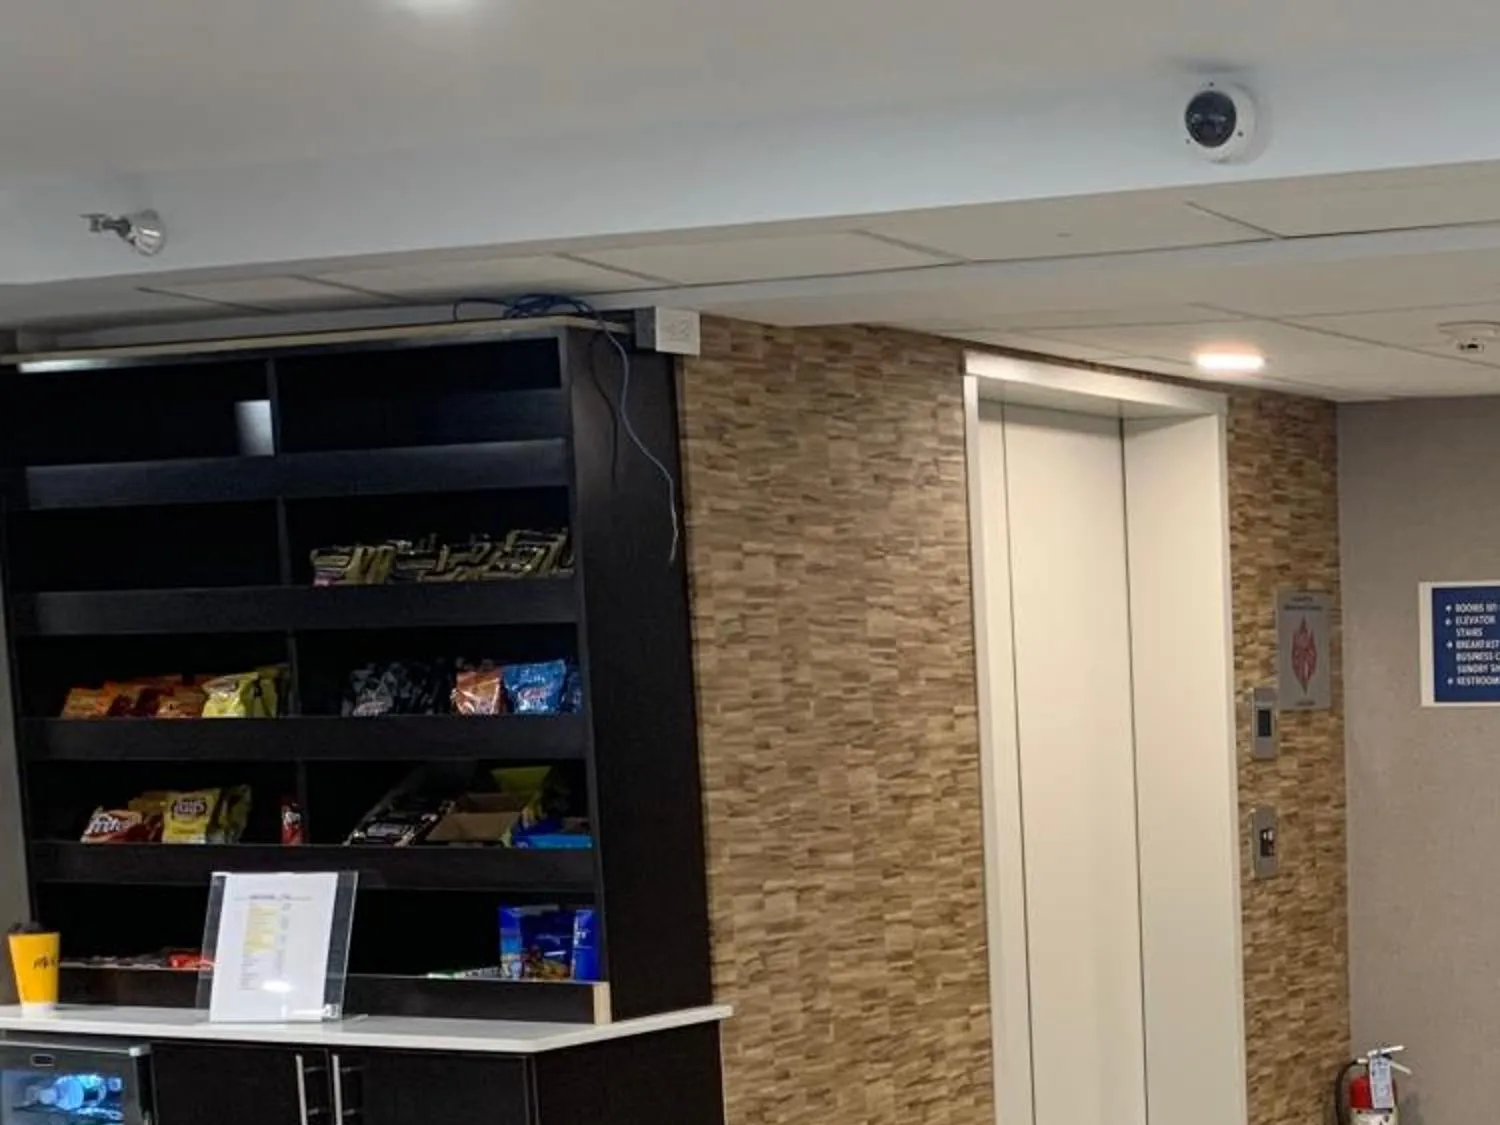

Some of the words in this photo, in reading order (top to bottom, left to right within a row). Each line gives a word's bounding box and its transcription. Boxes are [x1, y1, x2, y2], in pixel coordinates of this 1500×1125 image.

[1455, 603, 1484, 613] ROOMS
[1455, 615, 1496, 625] ELEVATOR
[1456, 627, 1483, 637] STAIRS
[1455, 640, 1500, 649] BREAKFAST
[1455, 652, 1493, 662] BUSINESS
